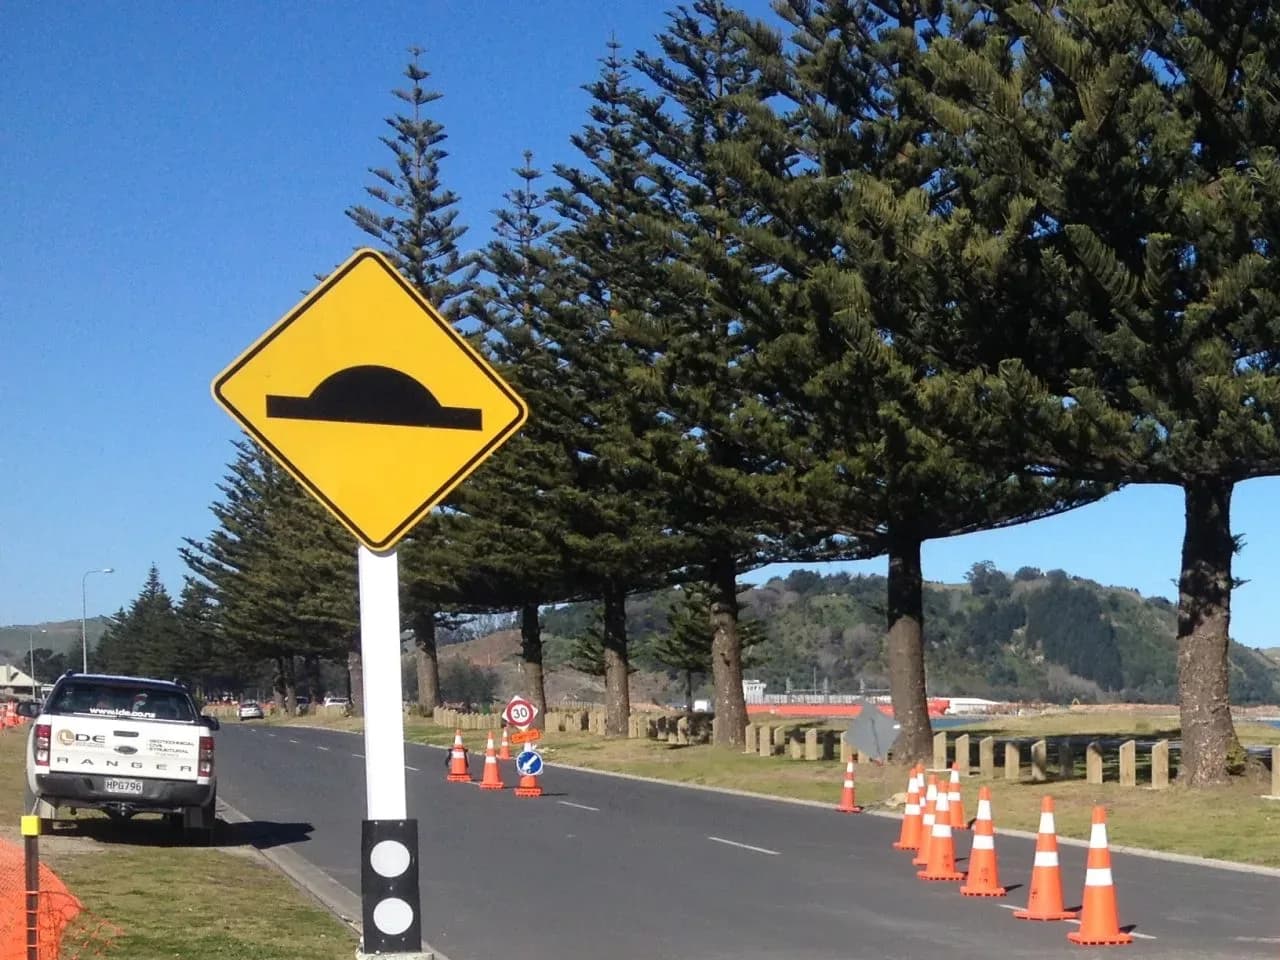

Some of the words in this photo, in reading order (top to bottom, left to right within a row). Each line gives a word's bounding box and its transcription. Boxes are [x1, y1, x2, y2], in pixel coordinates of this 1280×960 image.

[89, 707, 156, 718] www.lde.co.nz
[513, 707, 528, 719] 30
[56, 757, 193, 772] RANGER
[106, 780, 142, 792] HPG796
